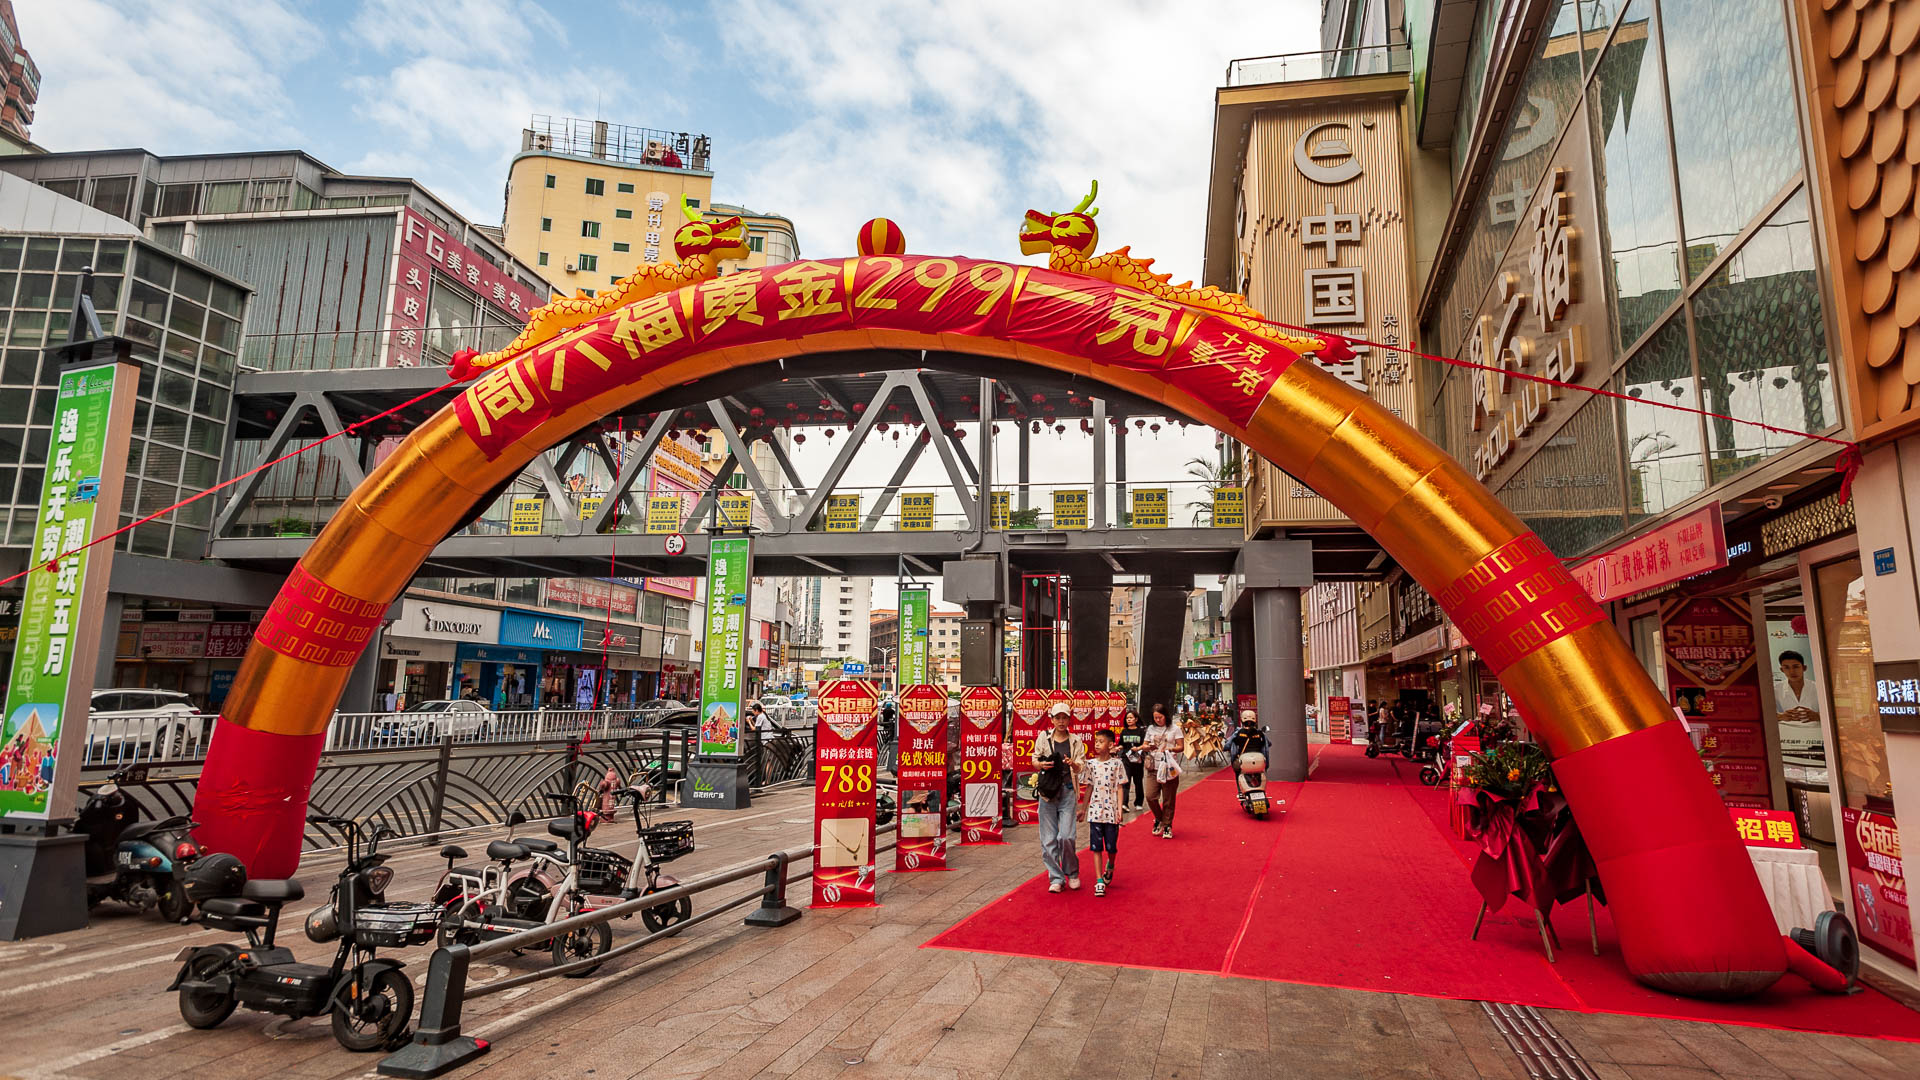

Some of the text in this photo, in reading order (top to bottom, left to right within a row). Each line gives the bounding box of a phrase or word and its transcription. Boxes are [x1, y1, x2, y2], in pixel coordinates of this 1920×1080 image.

[1222, 331, 1270, 365] 十克
[1382, 314, 1399, 384] 央企品牌
[1474, 325, 1577, 482] ZHOU LIU FU
[43, 518, 86, 675] 潮玩五月
[436, 620, 482, 634] DNCOBOY
[532, 621, 552, 640] Mt.
[1674, 647, 1747, 660] 感恩母亲节
[1186, 671, 1209, 679] luckin
[912, 738, 934, 749] 进店
[965, 745, 998, 757] 抢购价
[901, 751, 945, 766] 免费领取
[820, 764, 872, 793] 788
[962, 759, 992, 780] 99
[1736, 817, 1794, 843] 招聘
[1867, 851, 1903, 877] 感恩母亲
